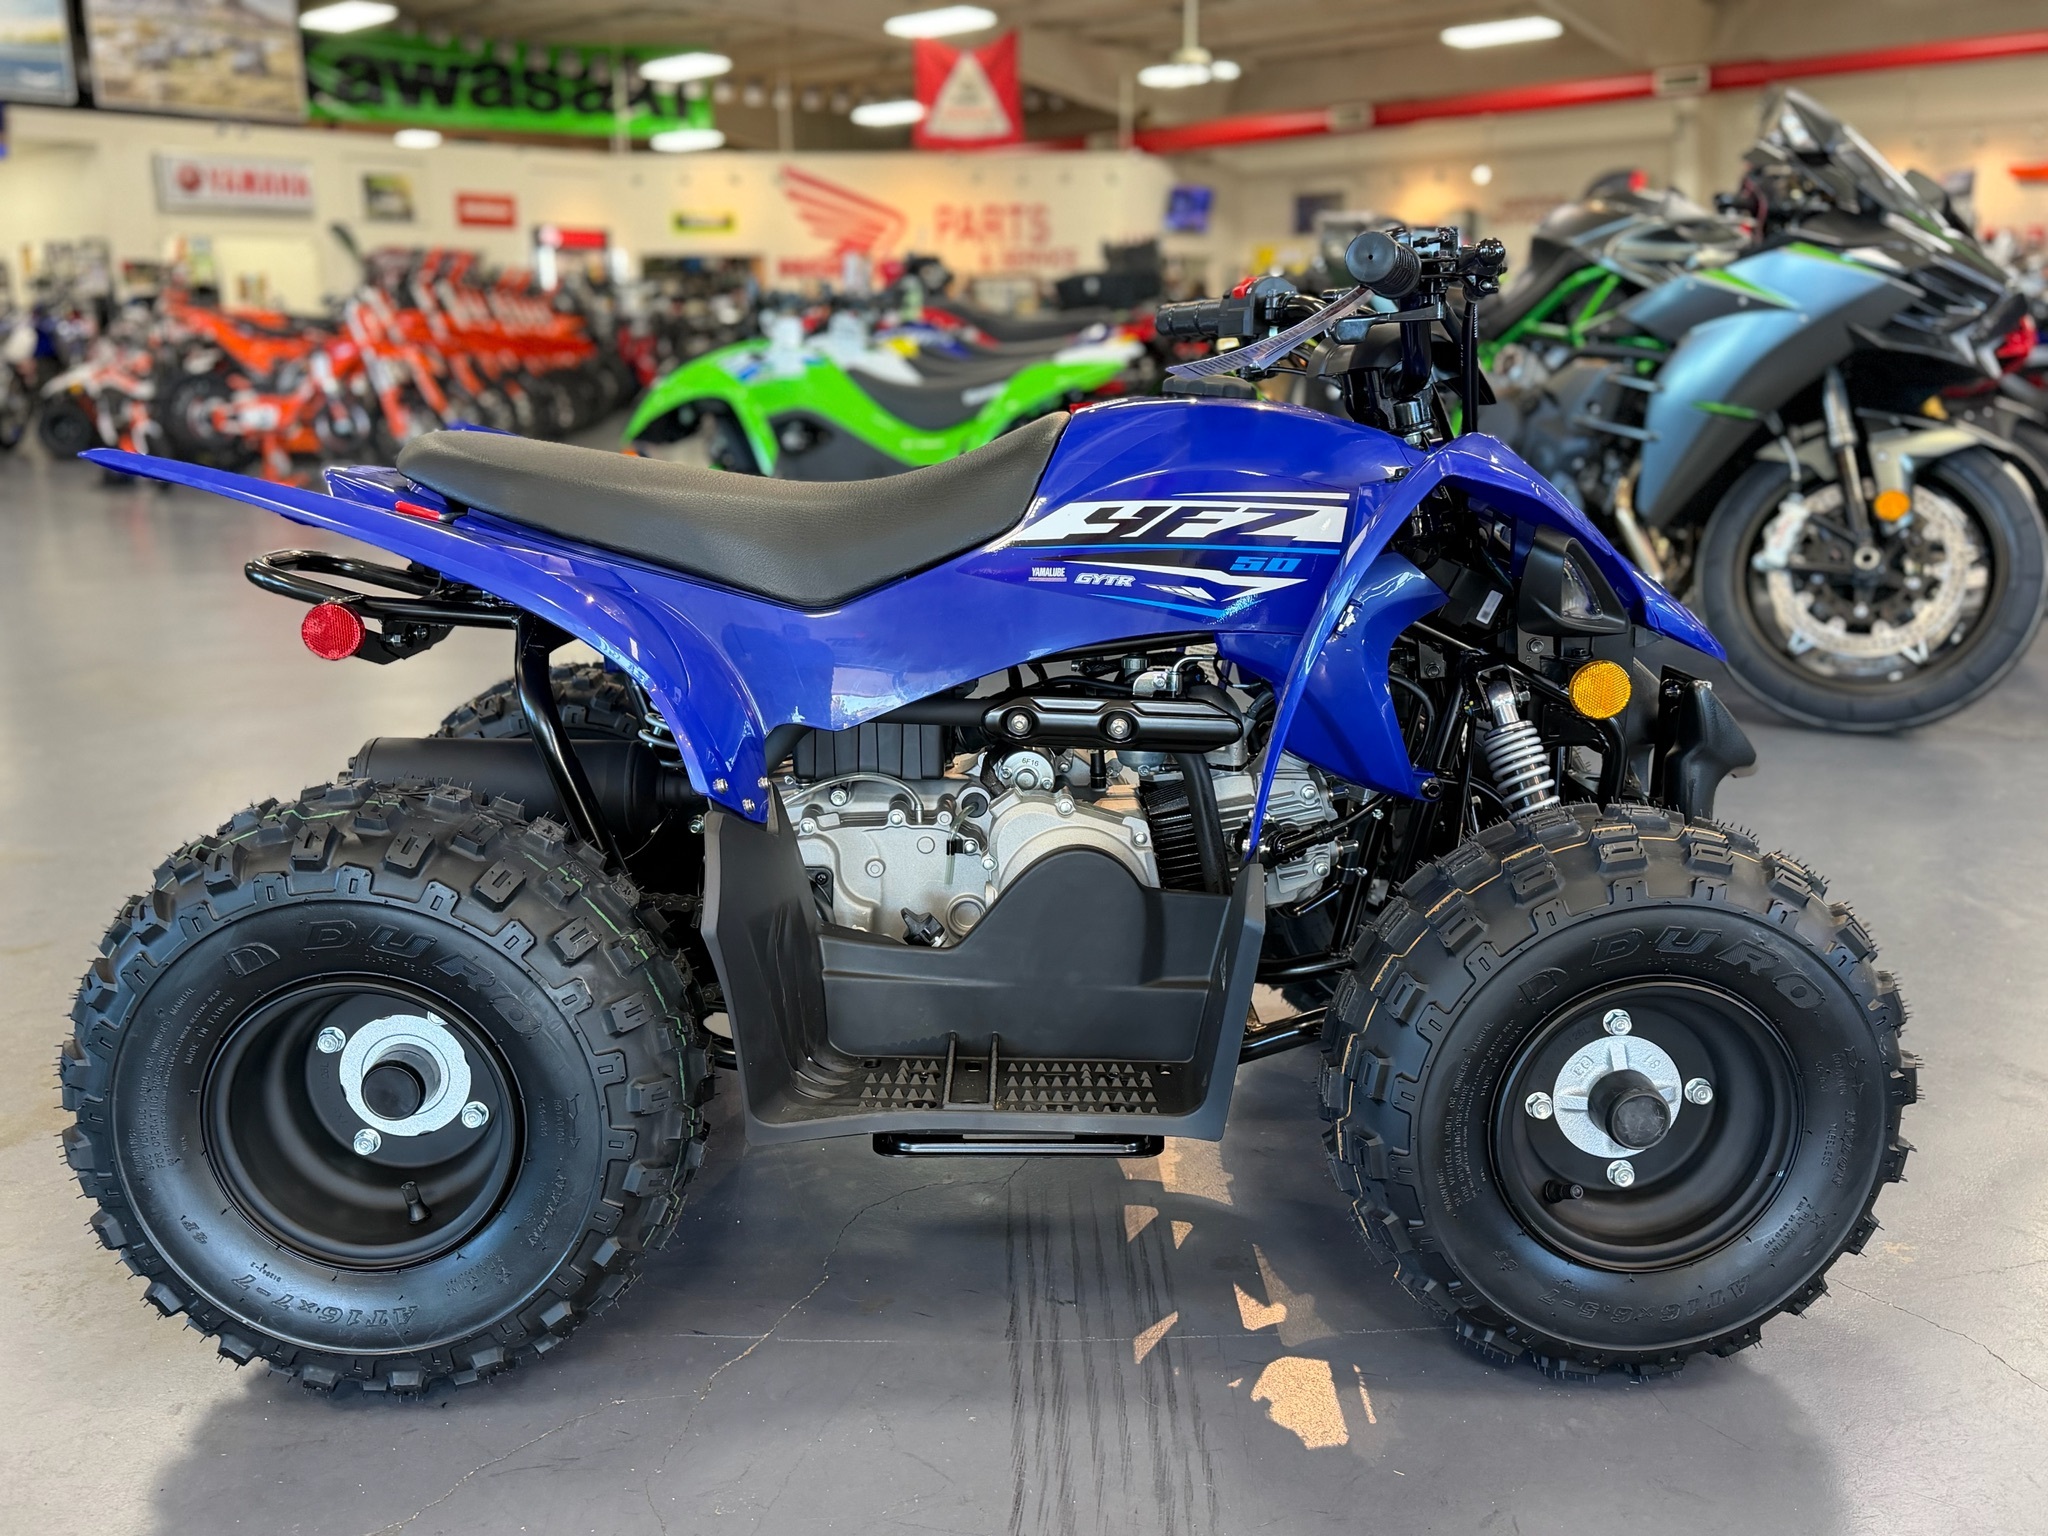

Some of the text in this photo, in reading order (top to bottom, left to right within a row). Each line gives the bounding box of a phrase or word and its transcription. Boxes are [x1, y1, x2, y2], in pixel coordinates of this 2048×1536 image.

[932, 202, 1051, 244] PARTS
[1082, 505, 1321, 542] YFZ
[1031, 566, 1067, 578] YAMALUBE
[1229, 555, 1303, 573] 50
[1074, 573, 1136, 588] GYTR
[302, 918, 543, 1036] DURO
[1590, 924, 1827, 1010] DURO
[206, 996, 236, 1025] TAIWAN
[1820, 1122, 1838, 1168] TUBELESS
[1795, 1211, 1810, 1228] PLY
[1767, 1228, 1797, 1257] RATING
